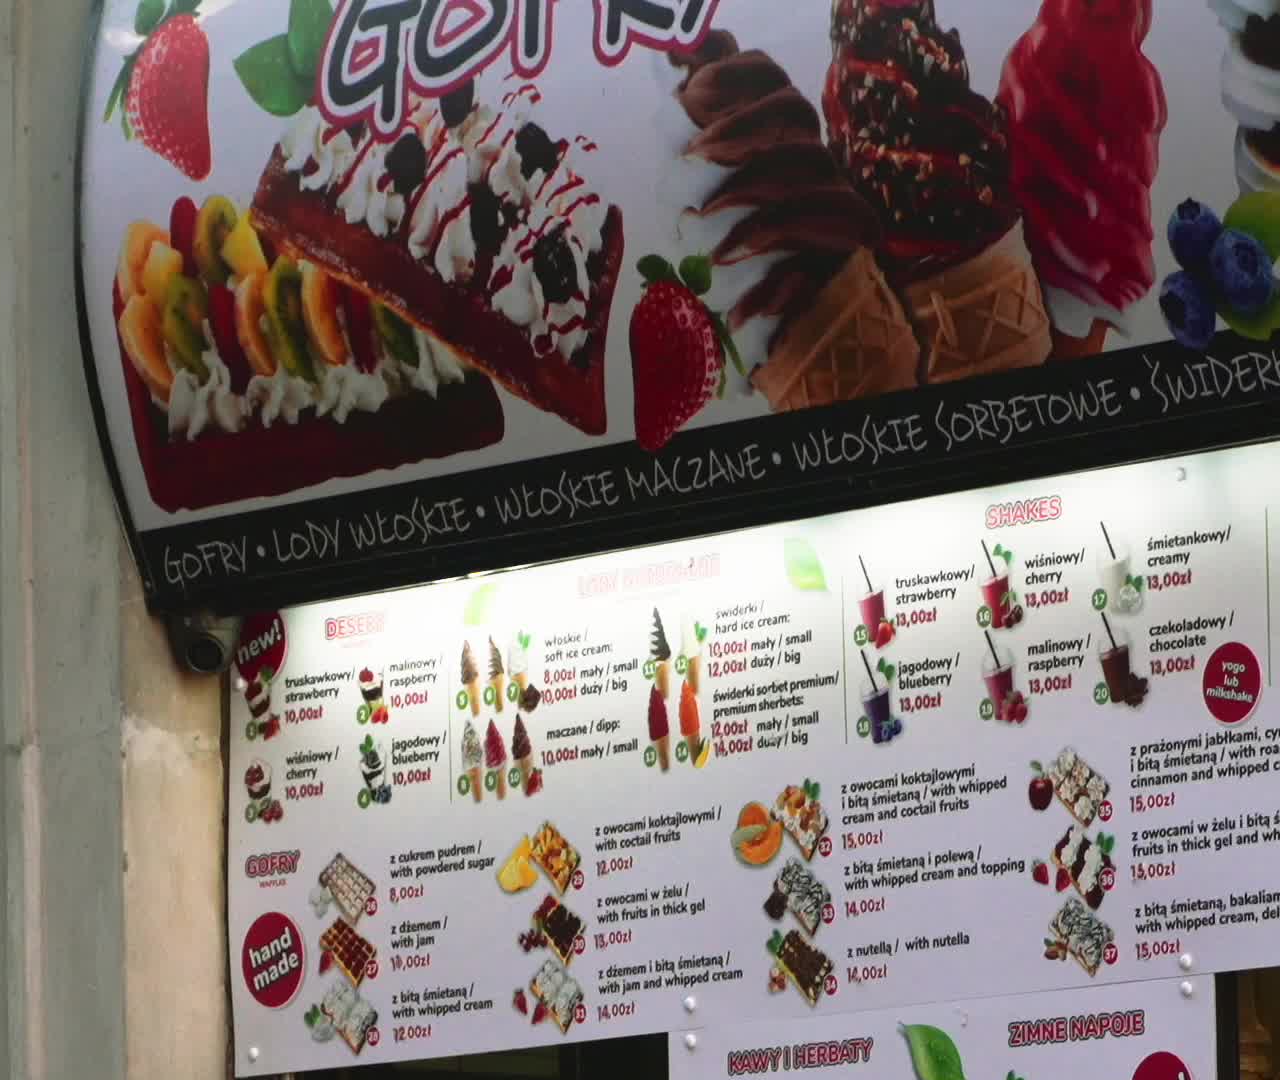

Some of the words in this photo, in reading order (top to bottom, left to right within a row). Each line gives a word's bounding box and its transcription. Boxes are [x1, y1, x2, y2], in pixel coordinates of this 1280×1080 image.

[163, 535, 246, 592] GOFRY
[272, 519, 339, 563] LODY
[348, 495, 471, 550] WŁOSKIE
[494, 470, 620, 526] WŁOSKIE
[625, 443, 767, 499] MACZANE
[792, 414, 928, 471] WŁOSKIE
[934, 378, 1121, 452] SORBETOWE
[985, 495, 1063, 530] SHAKES
[1148, 552, 1190, 567] creamy
[1025, 571, 1062, 585] cherry
[1147, 568, 1192, 591] 13,00zł
[896, 588, 956, 605] strawberry
[1025, 587, 1069, 608] 13,00zł
[896, 607, 936, 628] 13,00zł
[1149, 617, 1226, 636] czekoladowy
[236, 618, 282, 665] new!
[786, 630, 812, 645] small
[1150, 635, 1206, 652] chocolate
[544, 667, 576, 685] 8,00zł
[613, 658, 638, 673] small
[708, 658, 747, 677] 12,00zł
[785, 652, 800, 664] big
[1028, 655, 1084, 672] raspberry
[1150, 655, 1195, 676] 13,00zł
[1221, 660, 1246, 673] yogo
[390, 674, 437, 687] raspberry
[612, 680, 627, 692] big
[898, 673, 952, 690] blueberry
[1029, 674, 1072, 695] 13,00zł
[1223, 676, 1240, 687] lub
[285, 688, 339, 704] strawberry
[391, 691, 427, 708] 10,00zł
[900, 692, 941, 712] 13,00zł
[1206, 686, 1254, 703] milkshake
[284, 705, 323, 724] 10,00zł
[714, 703, 757, 721] premium
[792, 711, 819, 727] small
[547, 725, 587, 740] maczane
[792, 730, 808, 745] big
[613, 738, 638, 754] small
[1140, 734, 1202, 758] prażonymi
[391, 750, 439, 765] blueberry
[1164, 747, 1217, 768] śmietaną
[286, 768, 317, 780] cherry
[392, 768, 431, 786] 10,00zł
[850, 774, 898, 794] owocami
[901, 763, 974, 786] koktajlowymi
[1131, 769, 1187, 788] cinnamon
[1192, 766, 1213, 780] and
[1217, 759, 1269, 778] whipped
[285, 782, 323, 800] 10,00zł
[872, 790, 920, 805] śmietaną
[931, 783, 955, 797] with
[959, 776, 1007, 794] whipped
[1130, 792, 1175, 812] 15,00zł
[842, 812, 874, 825] cream
[878, 806, 897, 820] and
[901, 801, 936, 818] coctail
[939, 799, 969, 812] fruits
[603, 821, 646, 835] owocami
[649, 810, 715, 832] koktajlowymi
[1142, 821, 1193, 840] owocami
[596, 838, 617, 852] with
[620, 832, 651, 848] coctail
[654, 829, 680, 843] fruits
[1132, 842, 1163, 856] fruits
[1181, 836, 1211, 851] thick
[1214, 833, 1232, 851] gel
[399, 850, 435, 863] cukrem
[438, 844, 475, 861] pudrem
[935, 850, 974, 867] polewą
[245, 850, 300, 878] GOFRY
[391, 866, 413, 879] with
[416, 858, 464, 878] powdered
[468, 857, 495, 870] sugar
[871, 870, 918, 888] whipped
[958, 863, 977, 877] and
[981, 860, 1025, 876] topping
[605, 888, 647, 906] owocami
[622, 906, 648, 920] fruits
[663, 902, 687, 915] thick
[690, 898, 705, 915] gel
[249, 927, 293, 968] hand
[933, 932, 969, 948] nutella
[253, 952, 299, 992] made
[606, 965, 646, 978] dżemem
[622, 980, 640, 995] jam
[1008, 1017, 1068, 1047] ZIMNE
[1069, 1009, 1145, 1041] NAPOJE
[728, 1047, 782, 1076] KAWY
[793, 1037, 873, 1070] HERBATY
